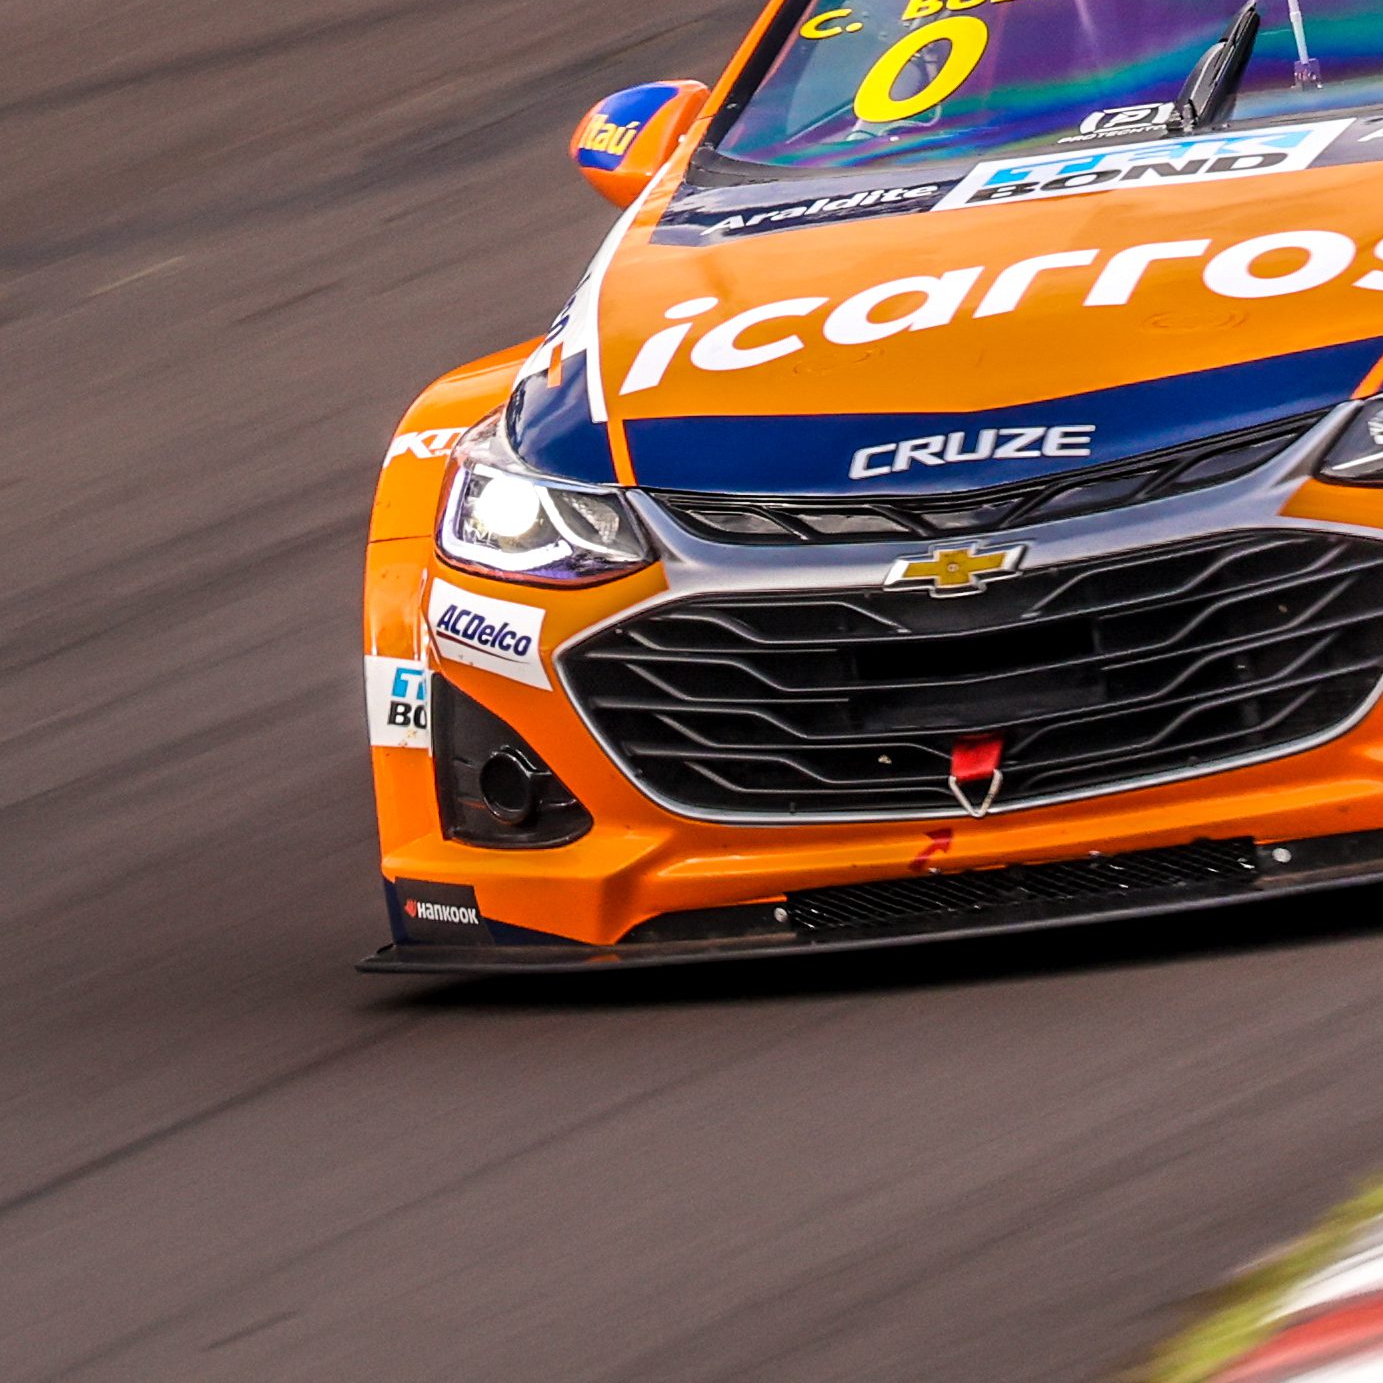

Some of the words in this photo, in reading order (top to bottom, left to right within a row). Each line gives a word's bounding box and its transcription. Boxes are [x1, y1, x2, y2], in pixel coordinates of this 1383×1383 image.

[800, 8, 863, 39] C.
[853, 15, 989, 124] 0
[579, 113, 641, 156] Itaú
[967, 152, 1289, 202] BOND
[701, 183, 939, 236] Araldite
[848, 424, 1096, 480] CRUZE
[435, 604, 533, 657] ACDelco
